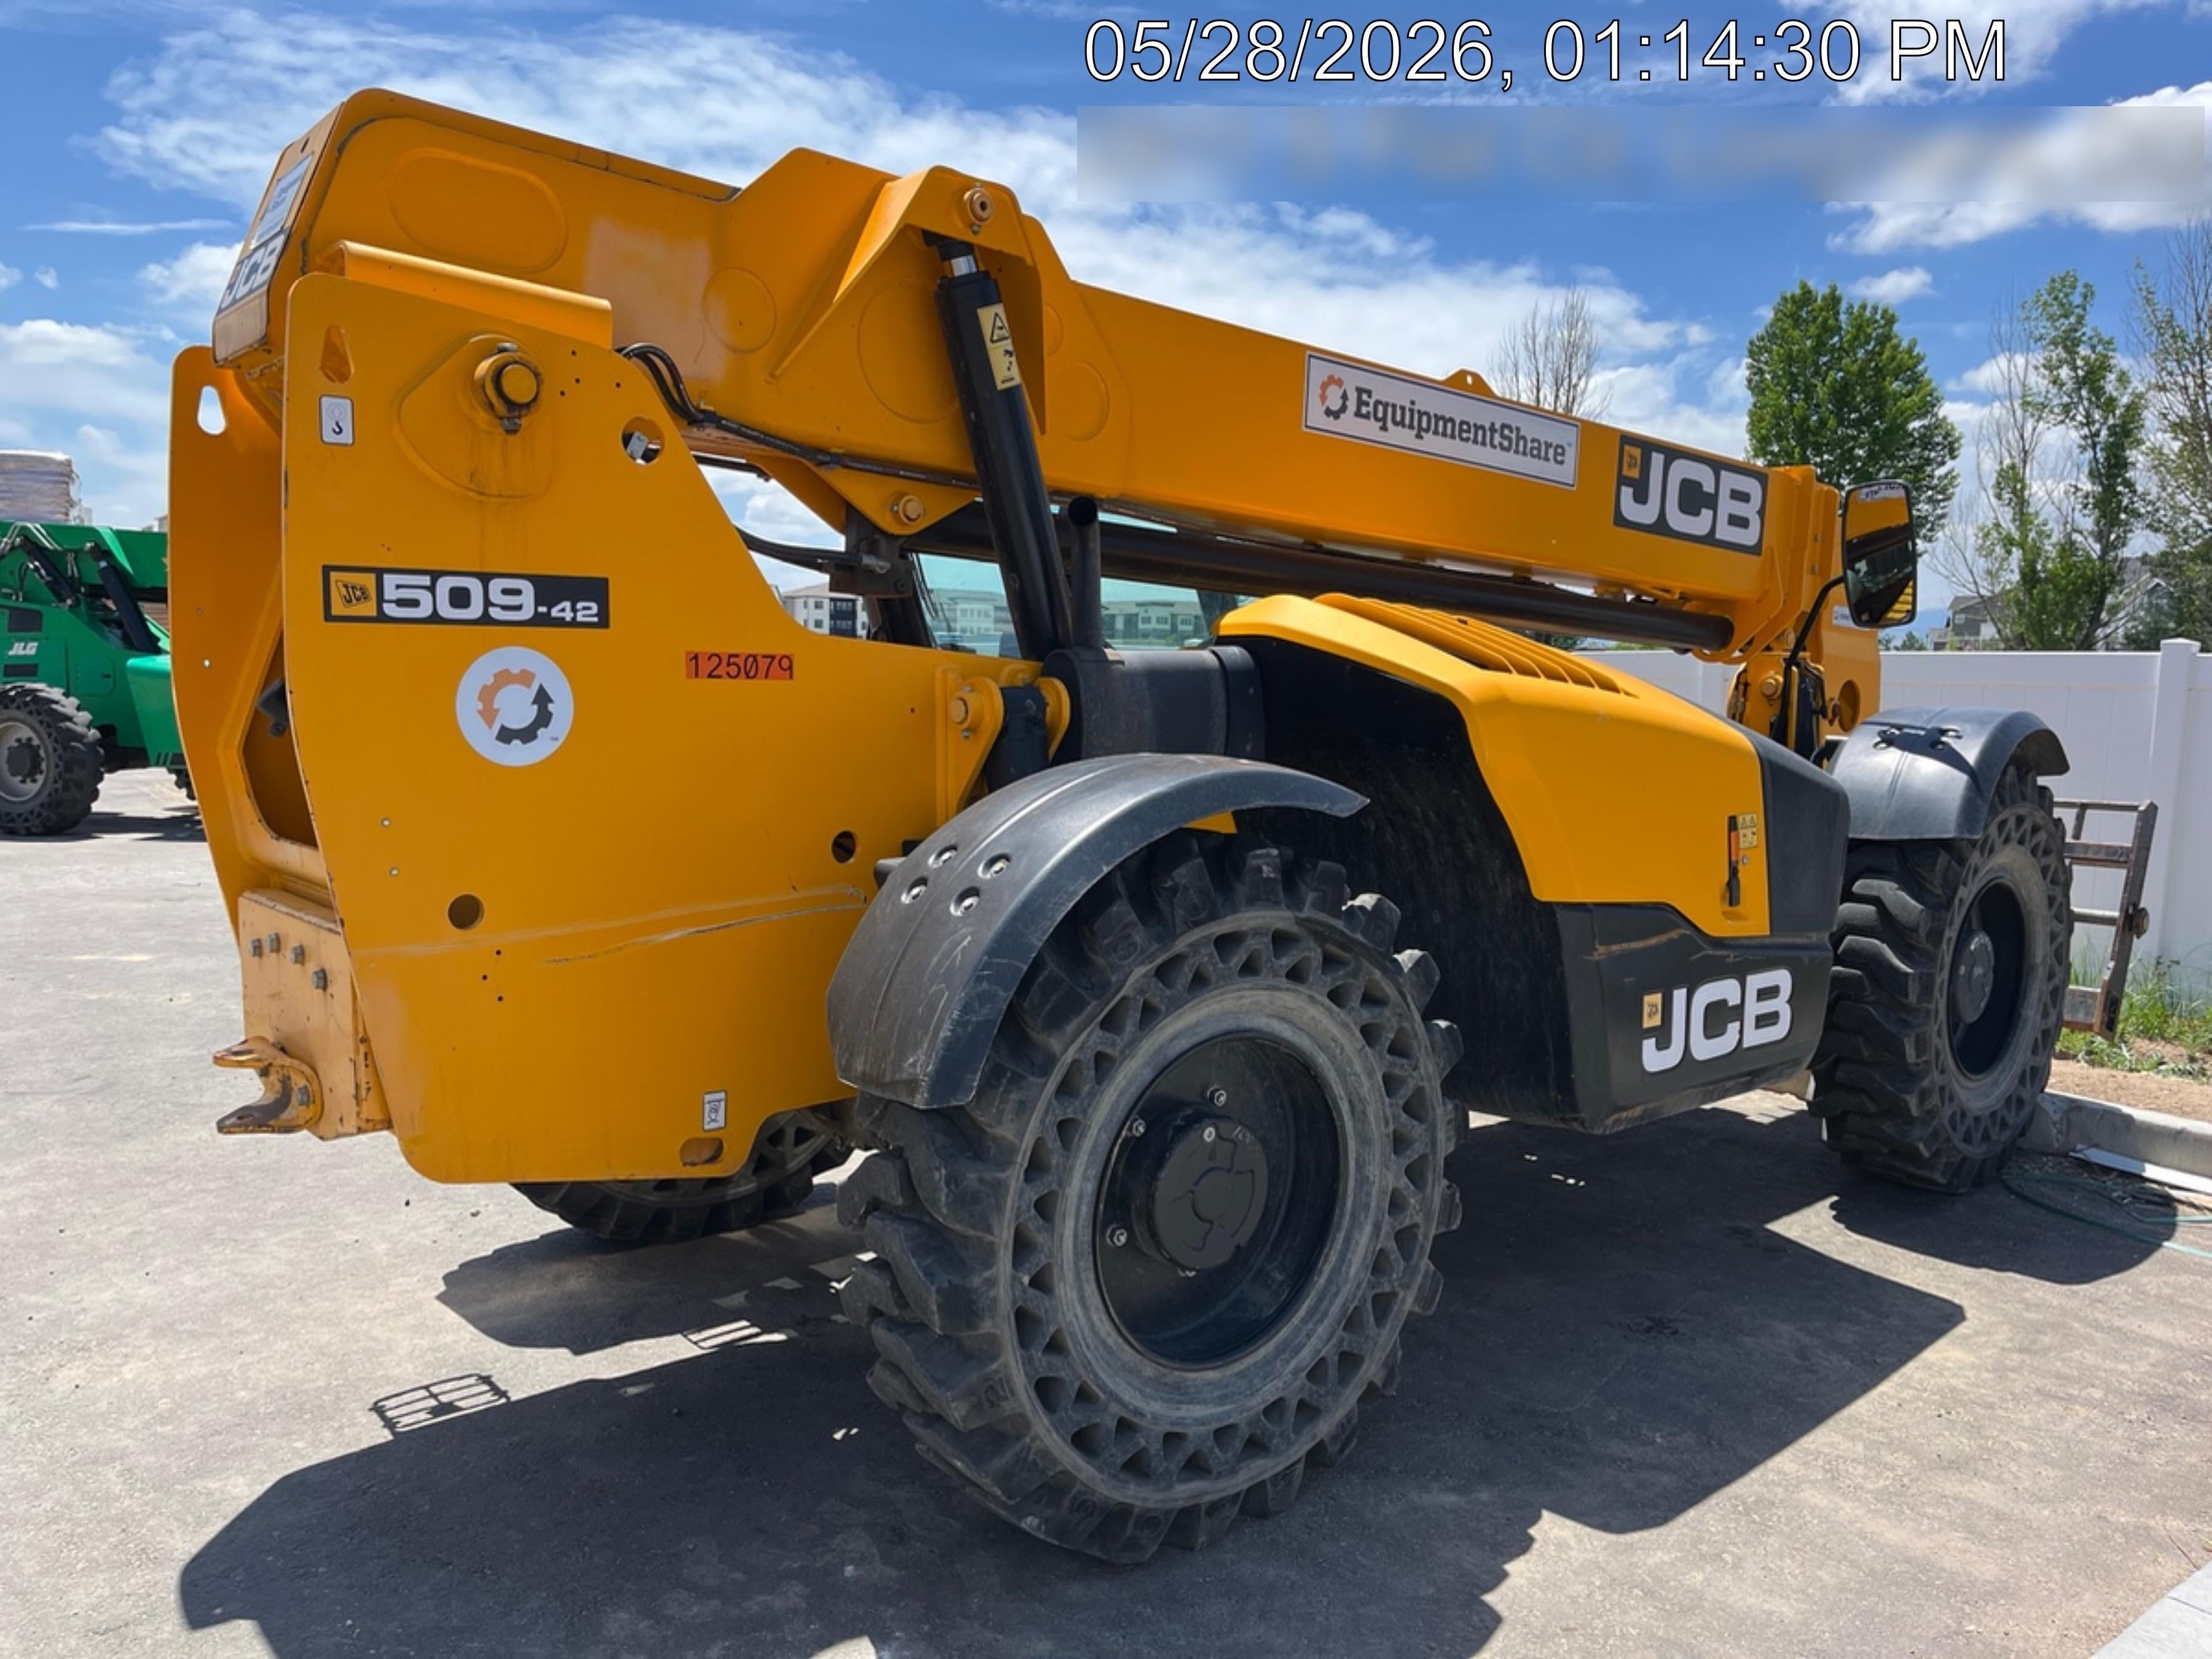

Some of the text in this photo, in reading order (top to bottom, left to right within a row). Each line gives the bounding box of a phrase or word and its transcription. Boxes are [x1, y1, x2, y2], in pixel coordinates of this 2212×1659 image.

[220, 234, 286, 309] JCB
[1354, 386, 1566, 466] EquipmentShare
[1620, 451, 1763, 546] JCB
[382, 573, 599, 622] 509-42
[8, 642, 39, 656] JLG
[689, 653, 793, 680] 125079
[1642, 969, 1792, 1073] JCB
